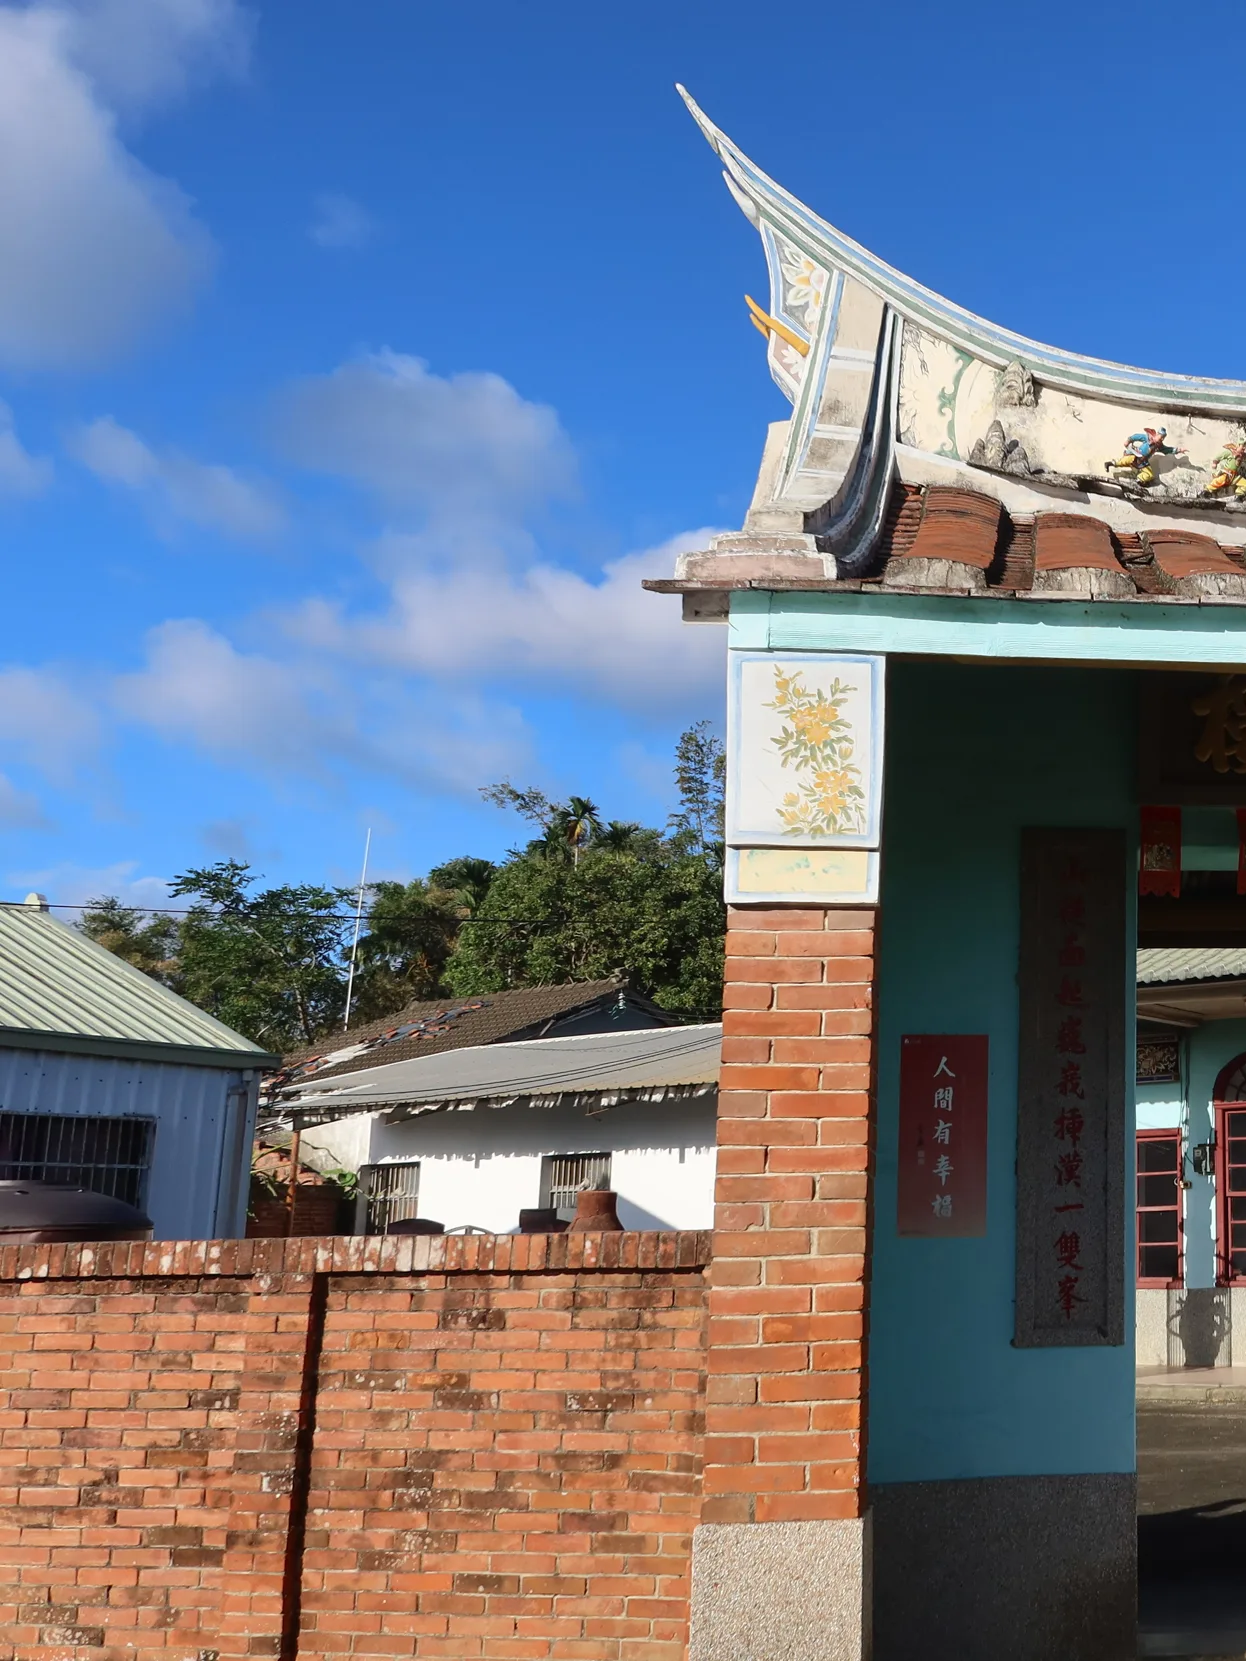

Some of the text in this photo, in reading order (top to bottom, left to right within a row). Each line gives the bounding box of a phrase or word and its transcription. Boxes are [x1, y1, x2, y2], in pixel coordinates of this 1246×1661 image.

[931, 1055, 956, 1219] 人間有幸福
